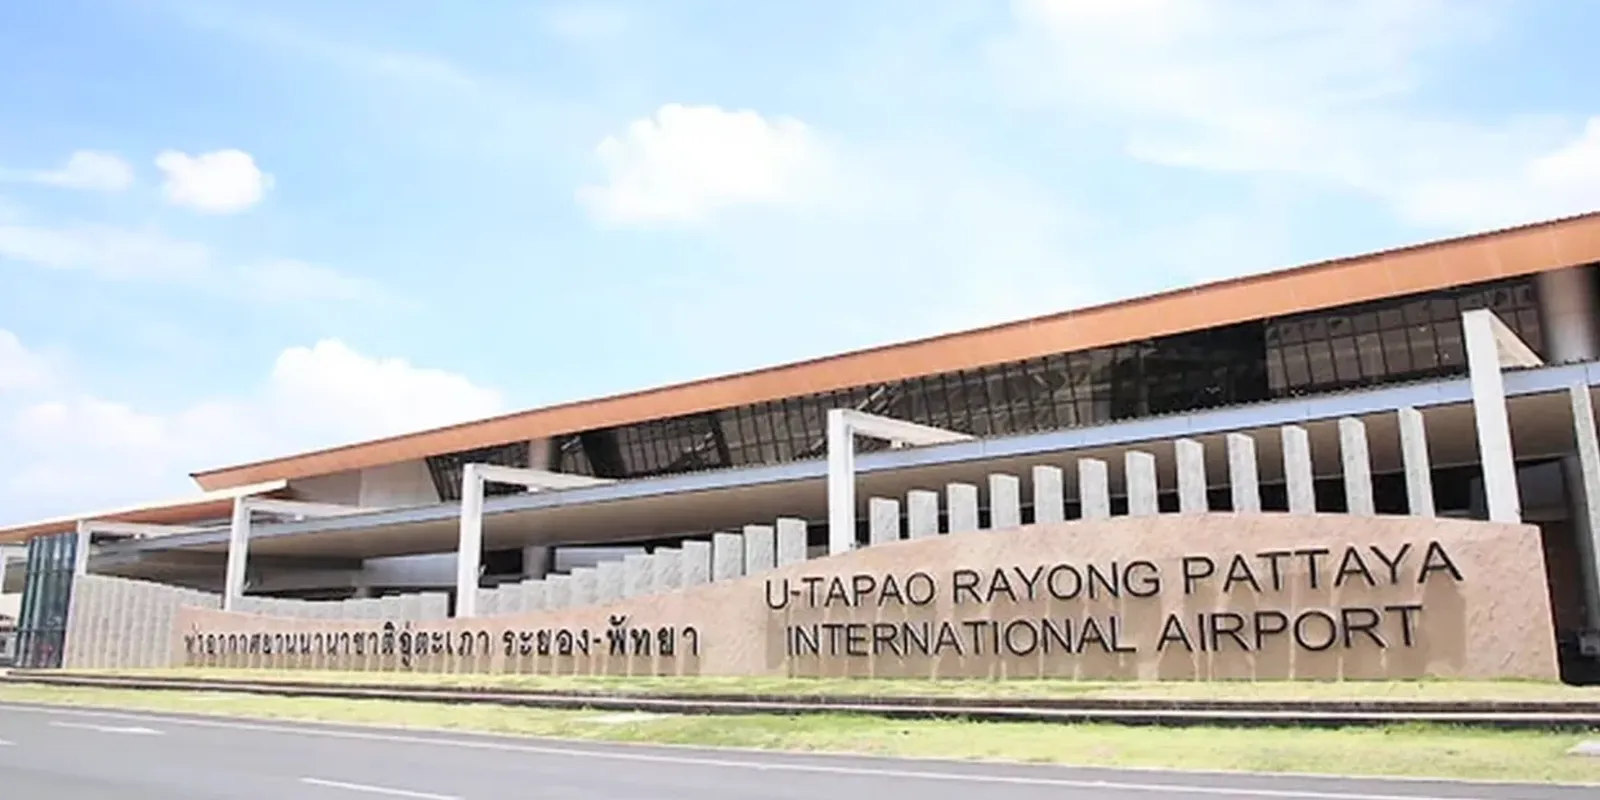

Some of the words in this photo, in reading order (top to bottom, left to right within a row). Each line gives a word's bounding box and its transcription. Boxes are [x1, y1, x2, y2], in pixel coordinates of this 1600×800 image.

[765, 572, 935, 610] U-TAPAO
[953, 560, 1161, 603] RAYONG
[1182, 541, 1464, 595] PATTAYA
[184, 621, 491, 667] ท่าอากาศยานนานาชาติอู่ตะเภา
[502, 614, 701, 657] ระยอง-พัทยา
[787, 615, 1137, 656] INTERNATIONAL
[1157, 605, 1423, 652] AIRPORT
